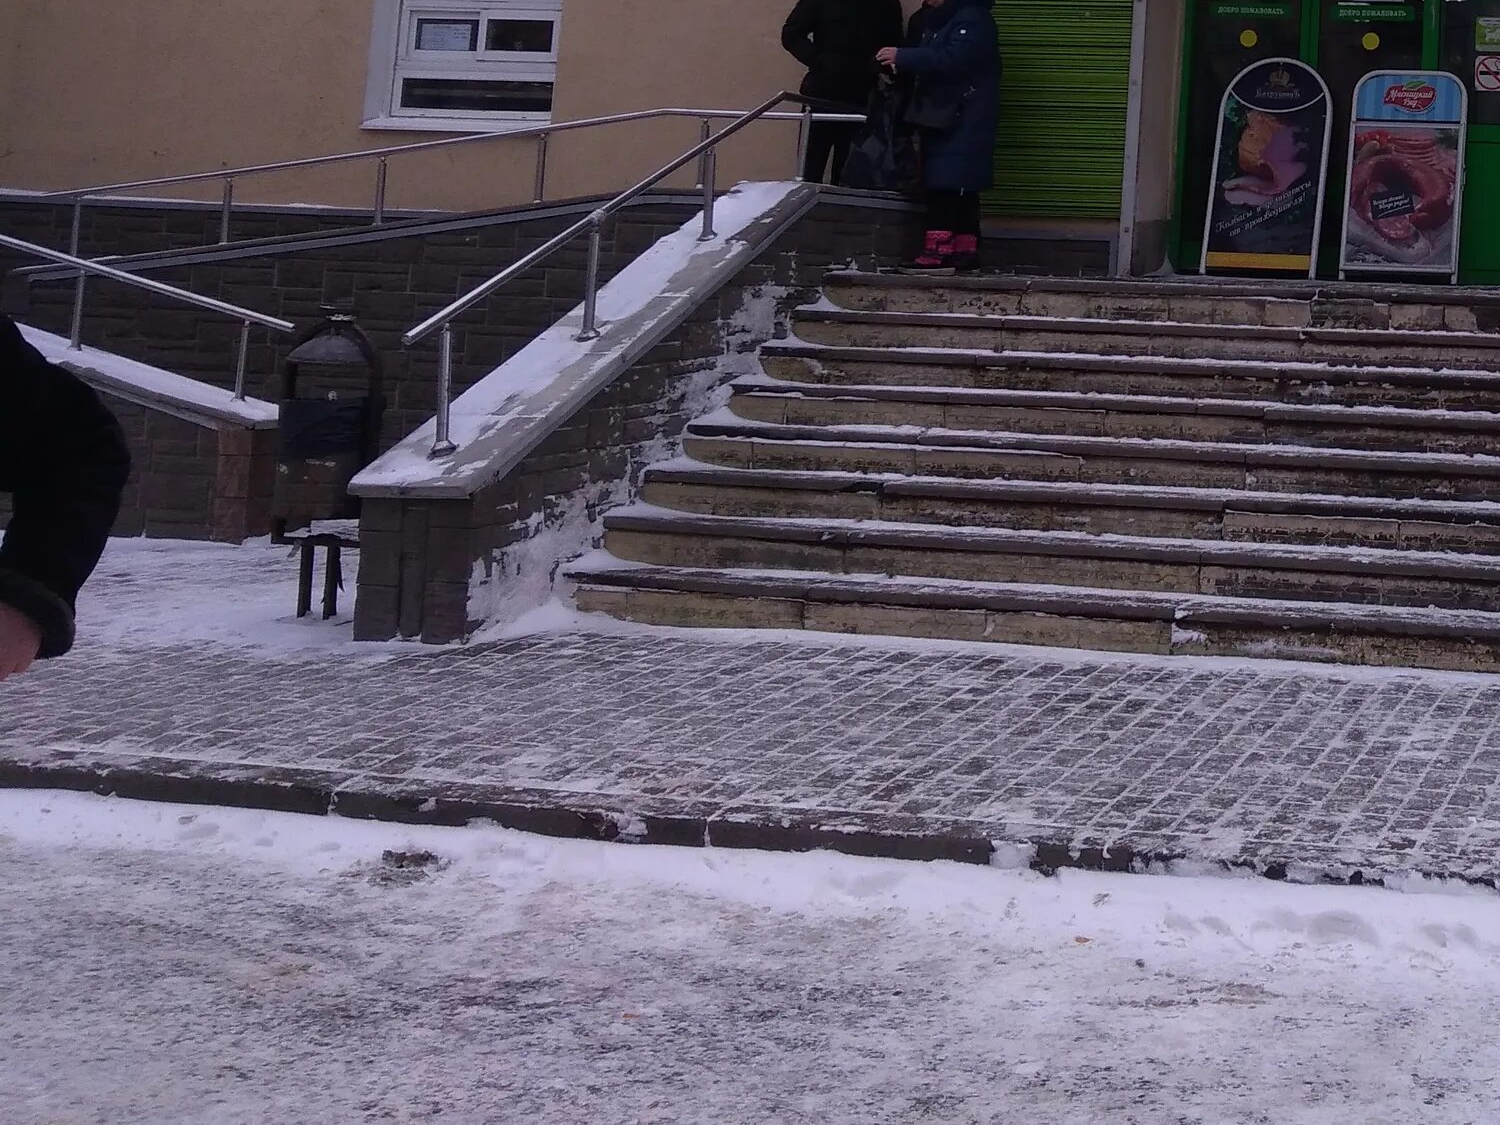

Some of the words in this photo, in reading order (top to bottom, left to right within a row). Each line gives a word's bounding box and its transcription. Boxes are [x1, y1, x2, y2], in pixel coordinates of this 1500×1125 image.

[1217, 6, 1239, 15] ДОБРО
[1338, 9, 1360, 17] ДОБРО
[1215, 209, 1252, 233] Колбасы
